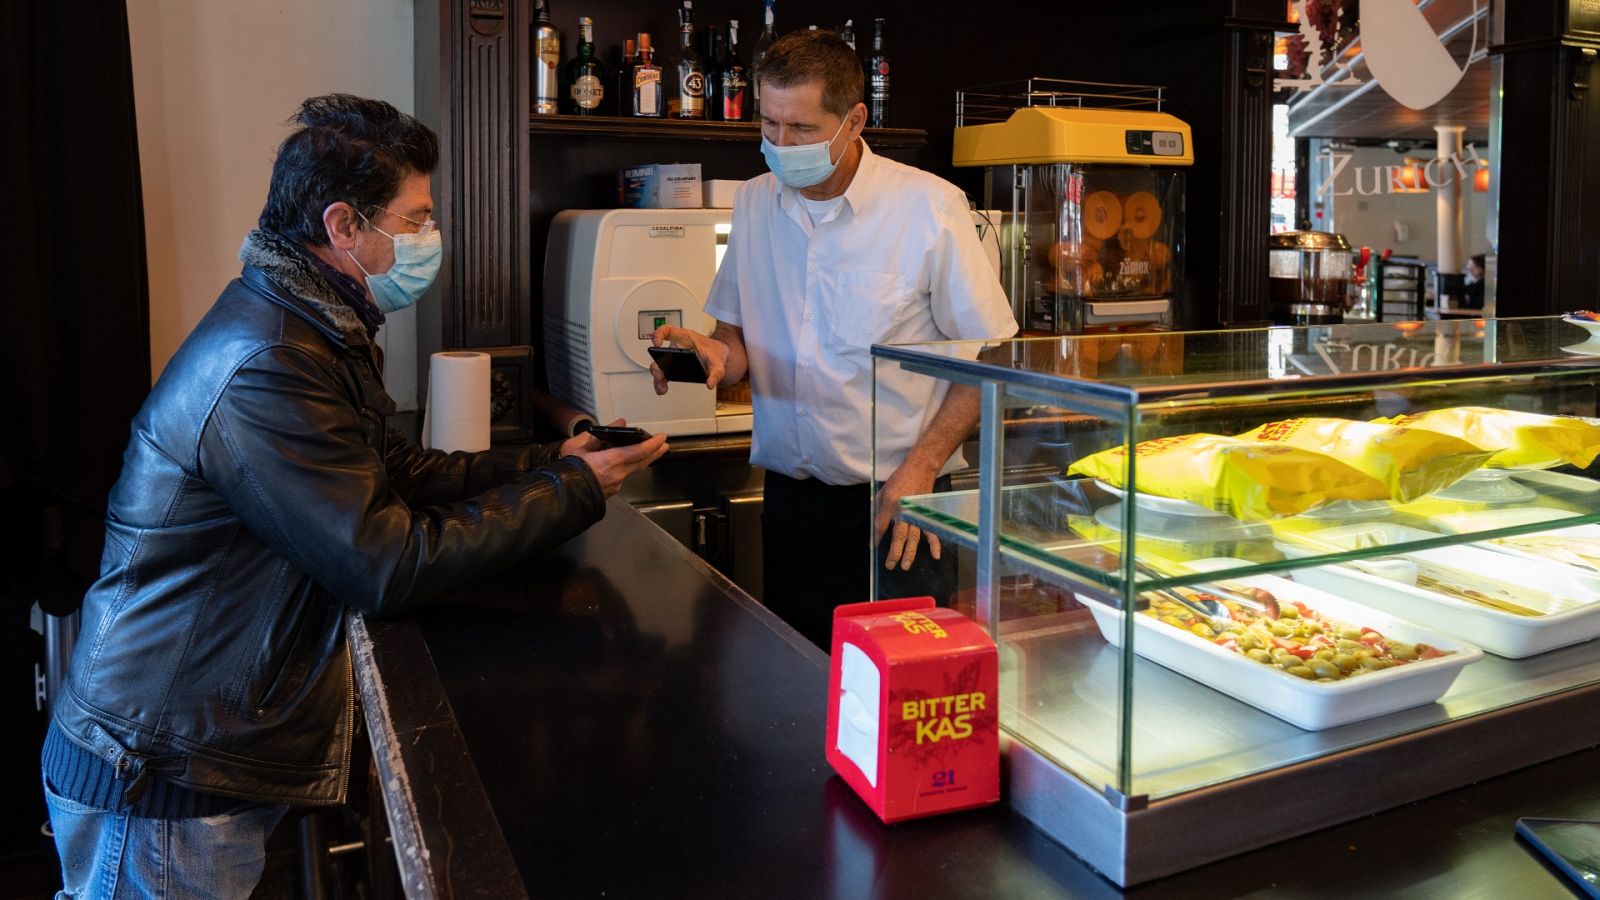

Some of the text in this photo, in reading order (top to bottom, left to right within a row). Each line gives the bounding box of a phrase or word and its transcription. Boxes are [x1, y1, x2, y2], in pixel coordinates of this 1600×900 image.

[688, 78, 702, 89] 43
[1315, 142, 1482, 196] ZURICH
[902, 691, 986, 721] BITTER
[916, 713, 973, 745] KAS
